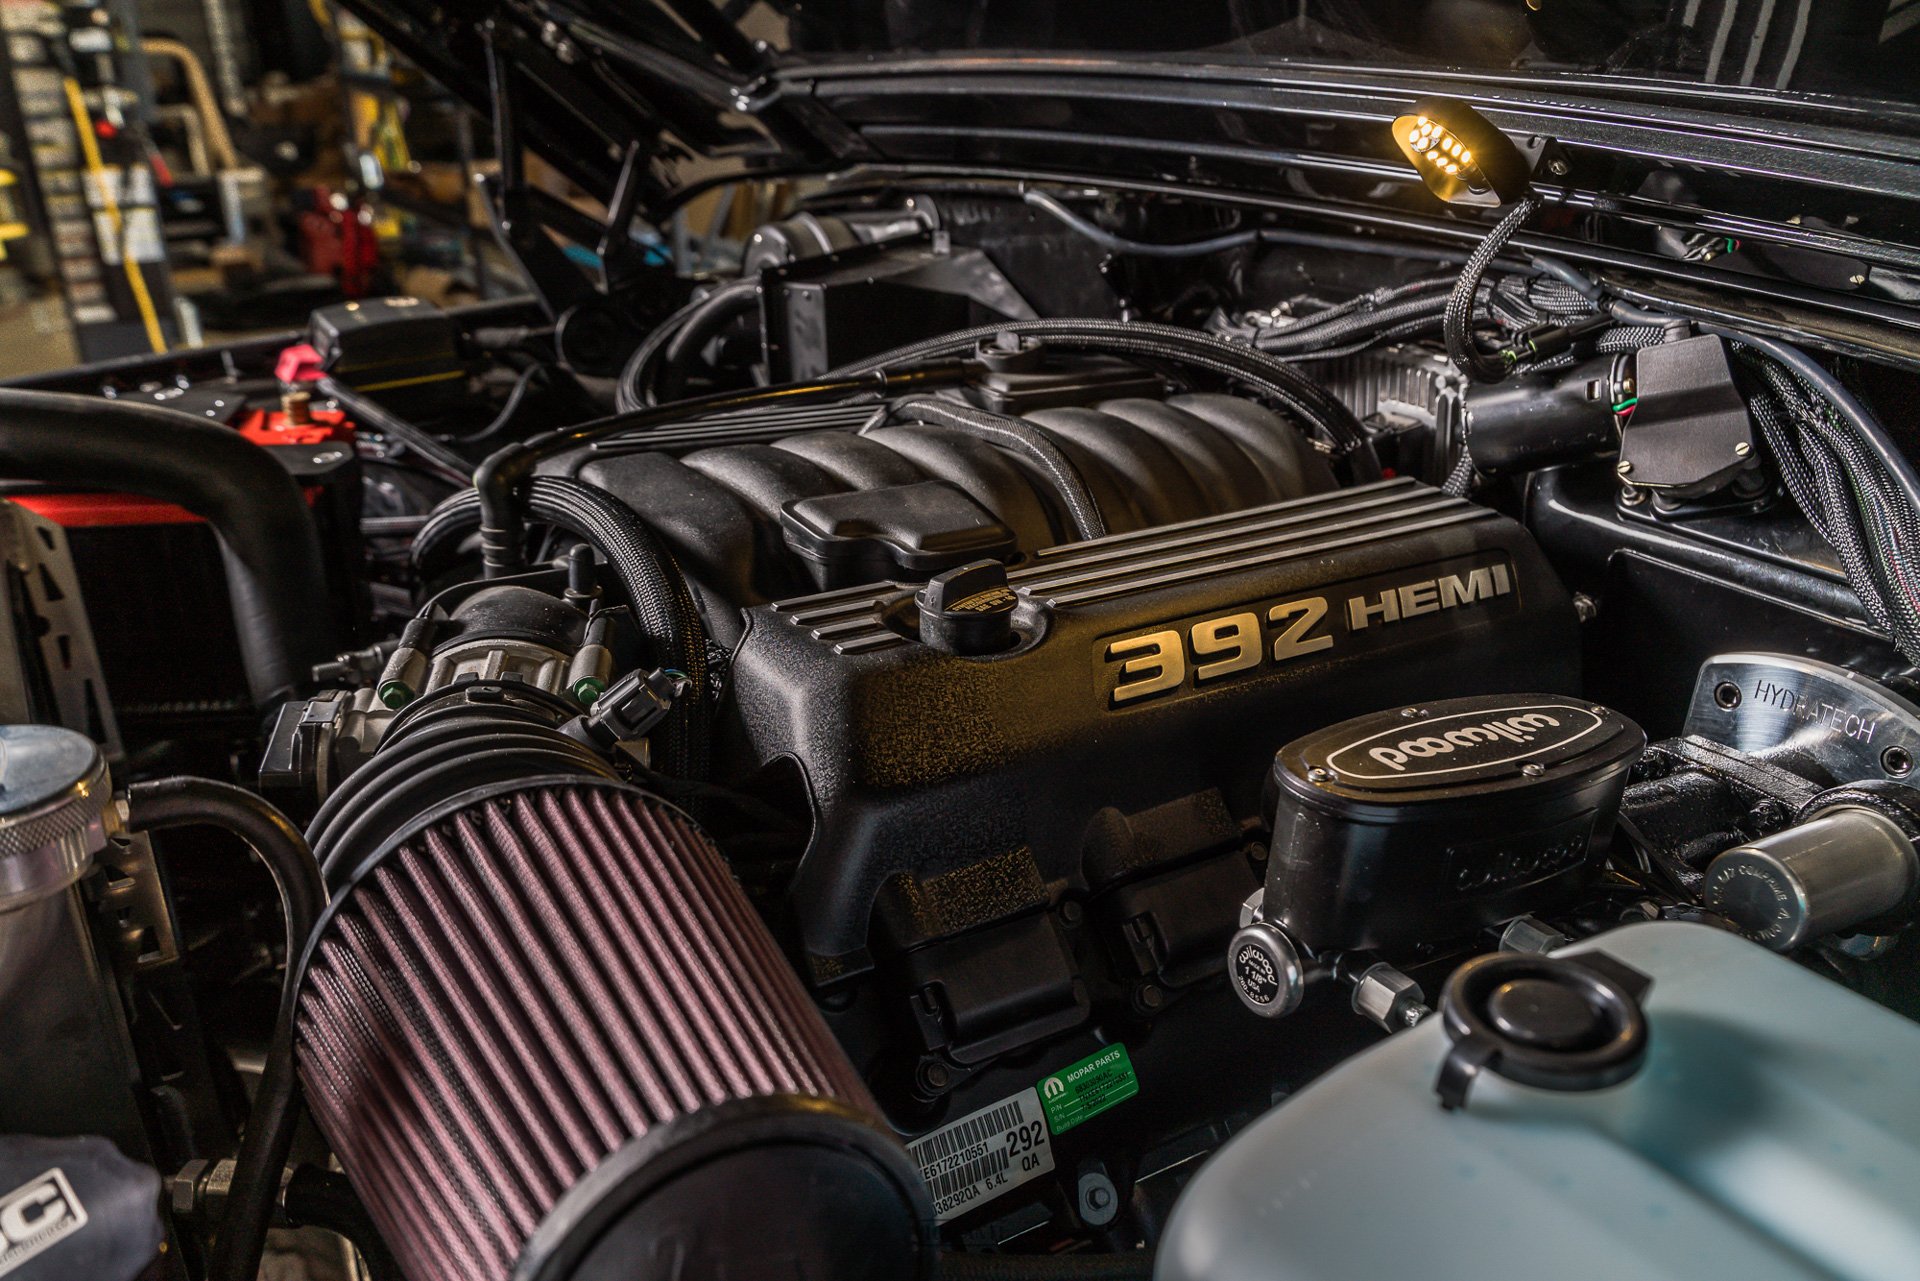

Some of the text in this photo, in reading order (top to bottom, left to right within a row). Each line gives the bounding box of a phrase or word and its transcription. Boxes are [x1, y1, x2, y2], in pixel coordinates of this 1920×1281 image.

[1110, 563, 1512, 702] 392 HEMI
[1753, 679, 1876, 744] HYDRATECH
[1368, 712, 1560, 771] wilwood
[1239, 945, 1278, 986] wilwood
[1066, 1050, 1121, 1084] MOPAR PARTS
[1006, 1120, 1046, 1158] 292
[919, 1141, 990, 1180] E6172210551
[1021, 1152, 1041, 1172] QA
[985, 1173, 1008, 1191] 6.4L
